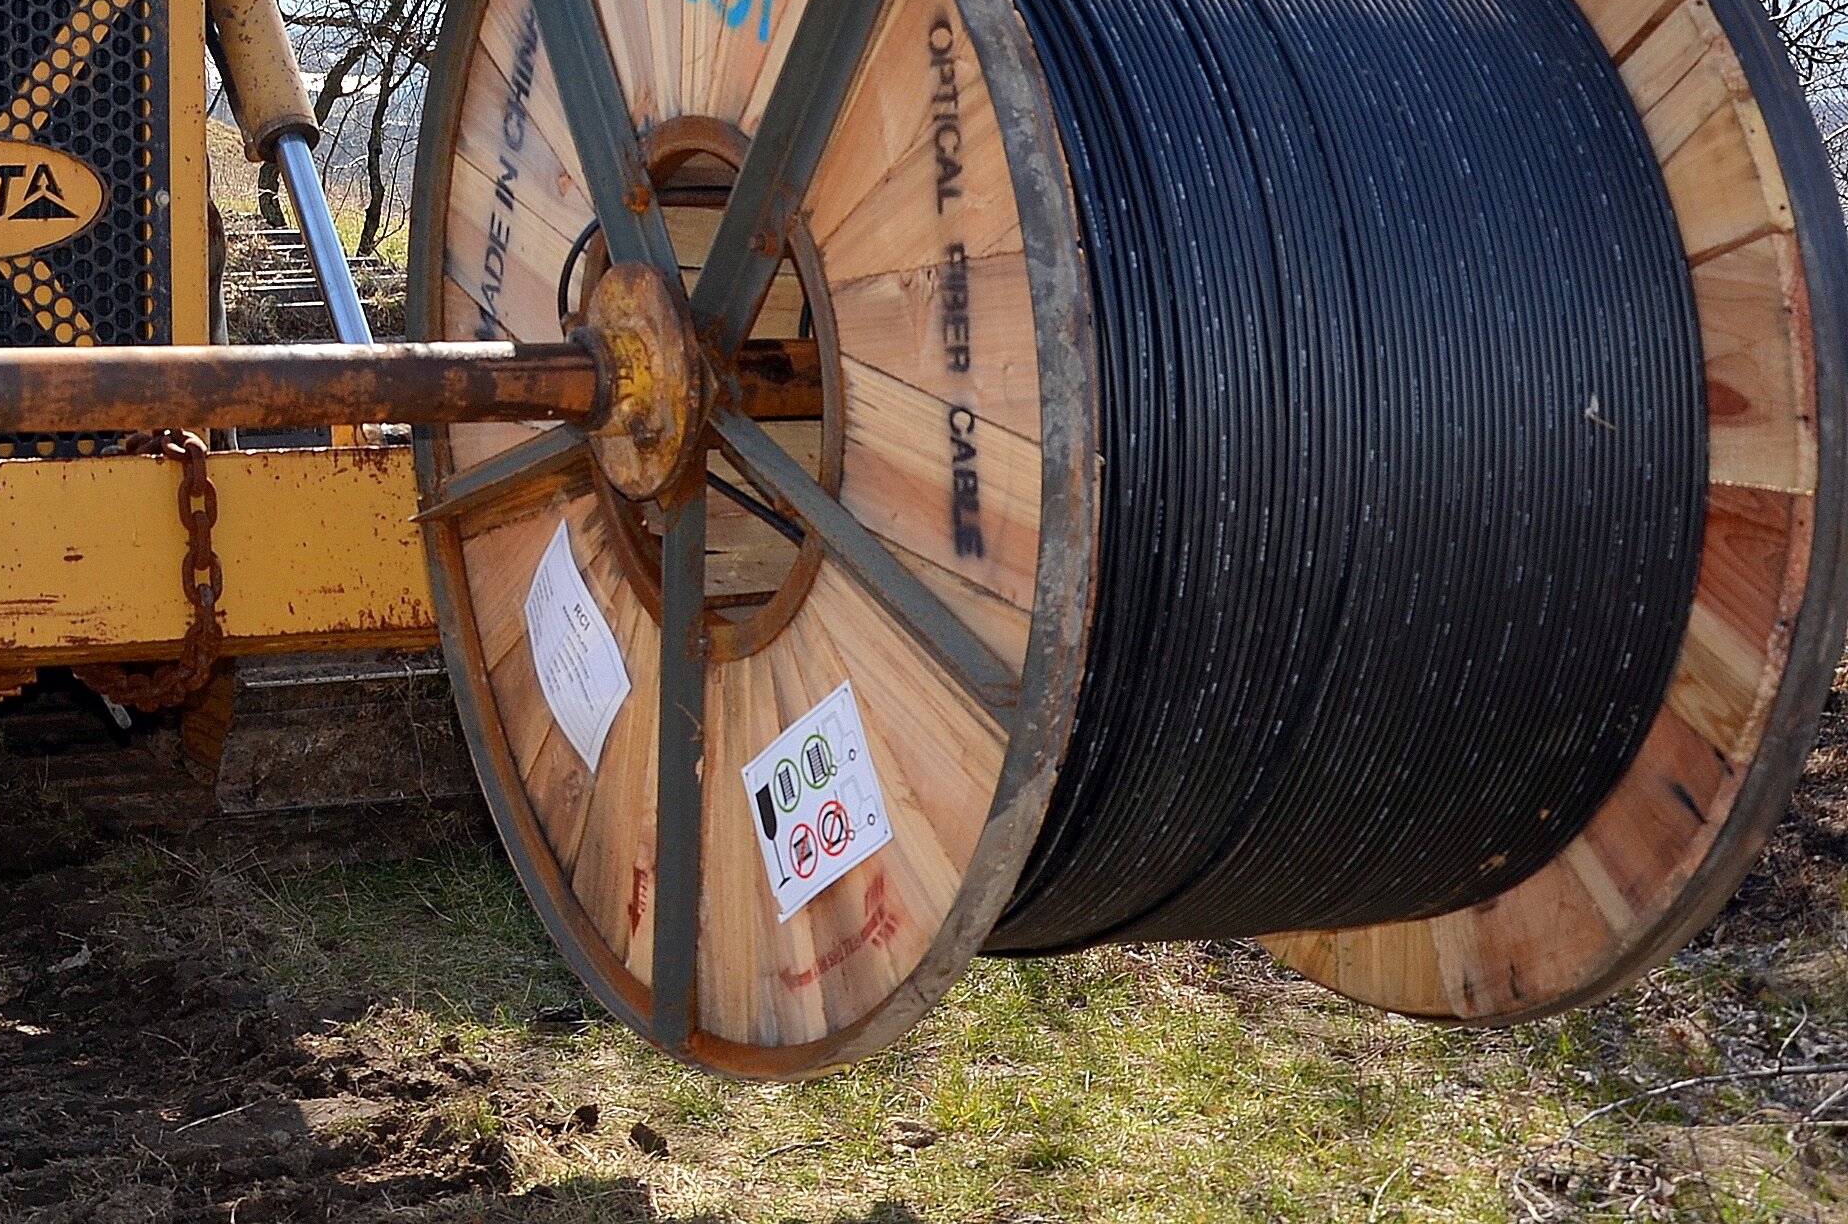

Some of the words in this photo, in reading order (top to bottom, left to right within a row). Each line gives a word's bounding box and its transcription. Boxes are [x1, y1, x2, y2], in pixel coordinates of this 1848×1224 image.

[928, 10, 963, 215] OPTICAL
[474, 211, 511, 340] MADE
[495, 155, 520, 212] IN
[941, 241, 971, 373] FIBER
[949, 403, 985, 559] CABLE
[573, 602, 591, 631] RCI
